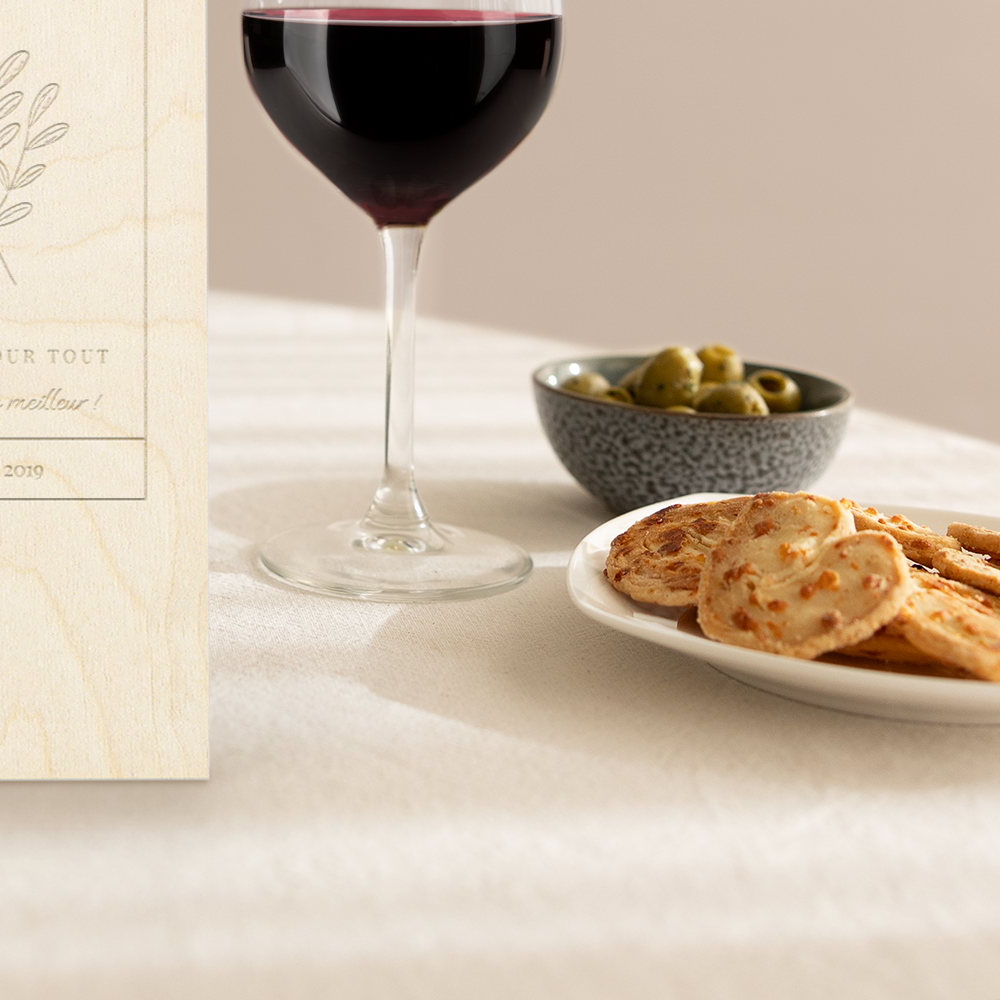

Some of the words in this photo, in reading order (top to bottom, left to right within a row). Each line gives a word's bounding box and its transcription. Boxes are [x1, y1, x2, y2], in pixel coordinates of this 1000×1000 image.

[47, 348, 110, 365] TOUT
[5, 387, 90, 411] meilleur
[3, 463, 45, 480] 2019
